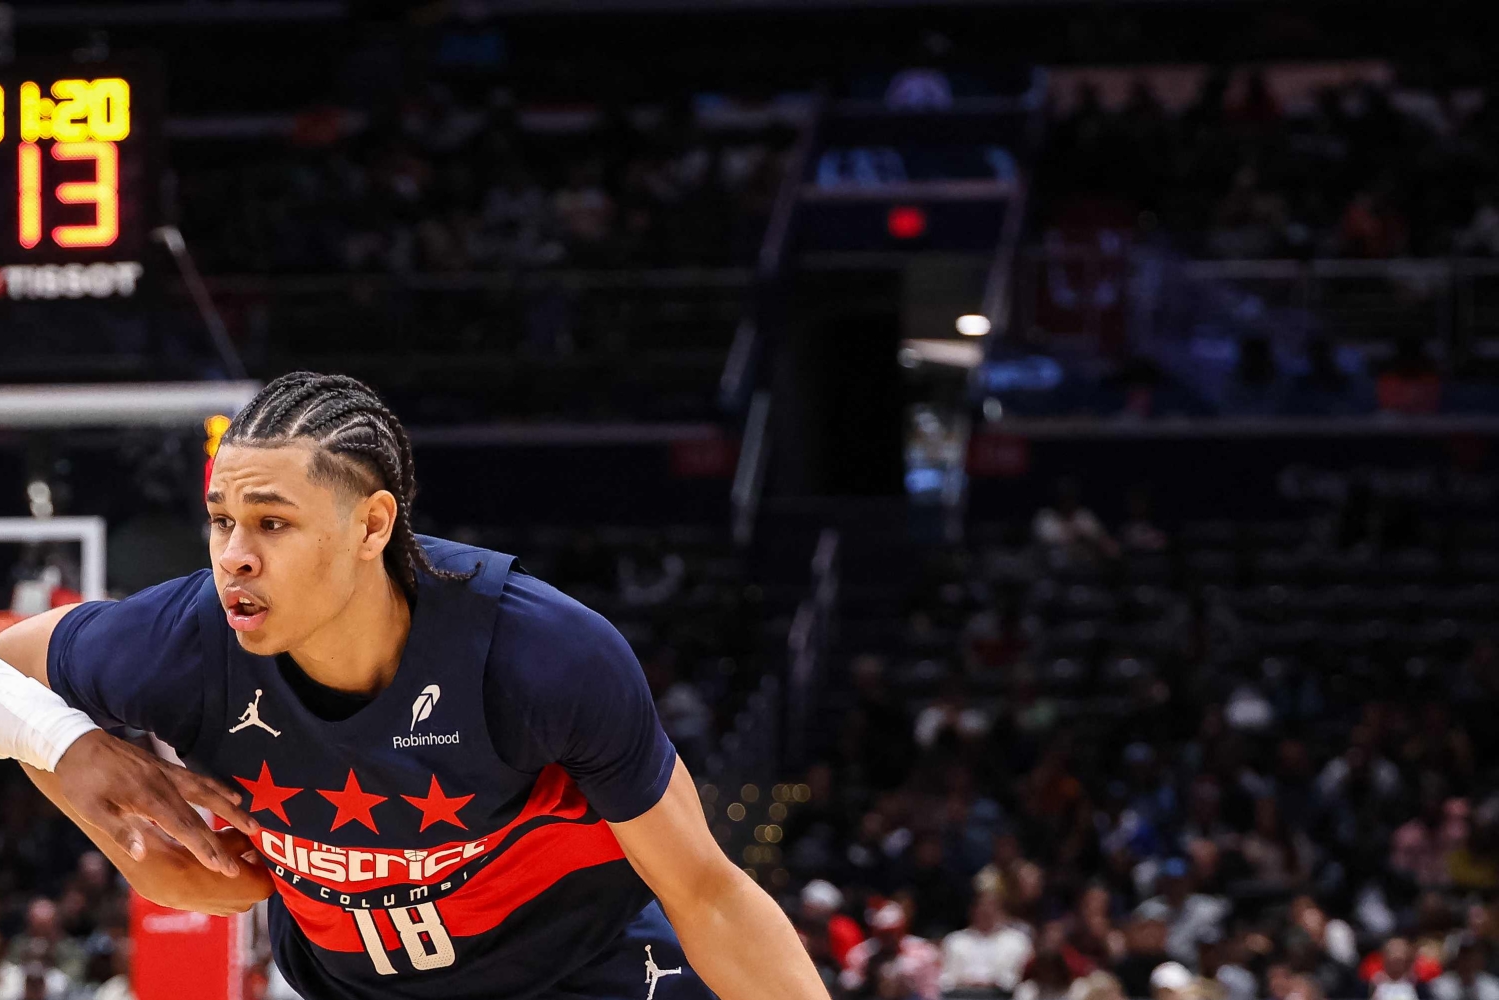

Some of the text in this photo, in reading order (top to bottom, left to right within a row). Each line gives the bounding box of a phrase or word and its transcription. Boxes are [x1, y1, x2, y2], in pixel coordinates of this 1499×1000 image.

[18, 141, 119, 249] 13
[392, 730, 460, 749] Robinhood
[275, 856, 488, 908] OF COLUMBI
[345, 901, 456, 976] 18
